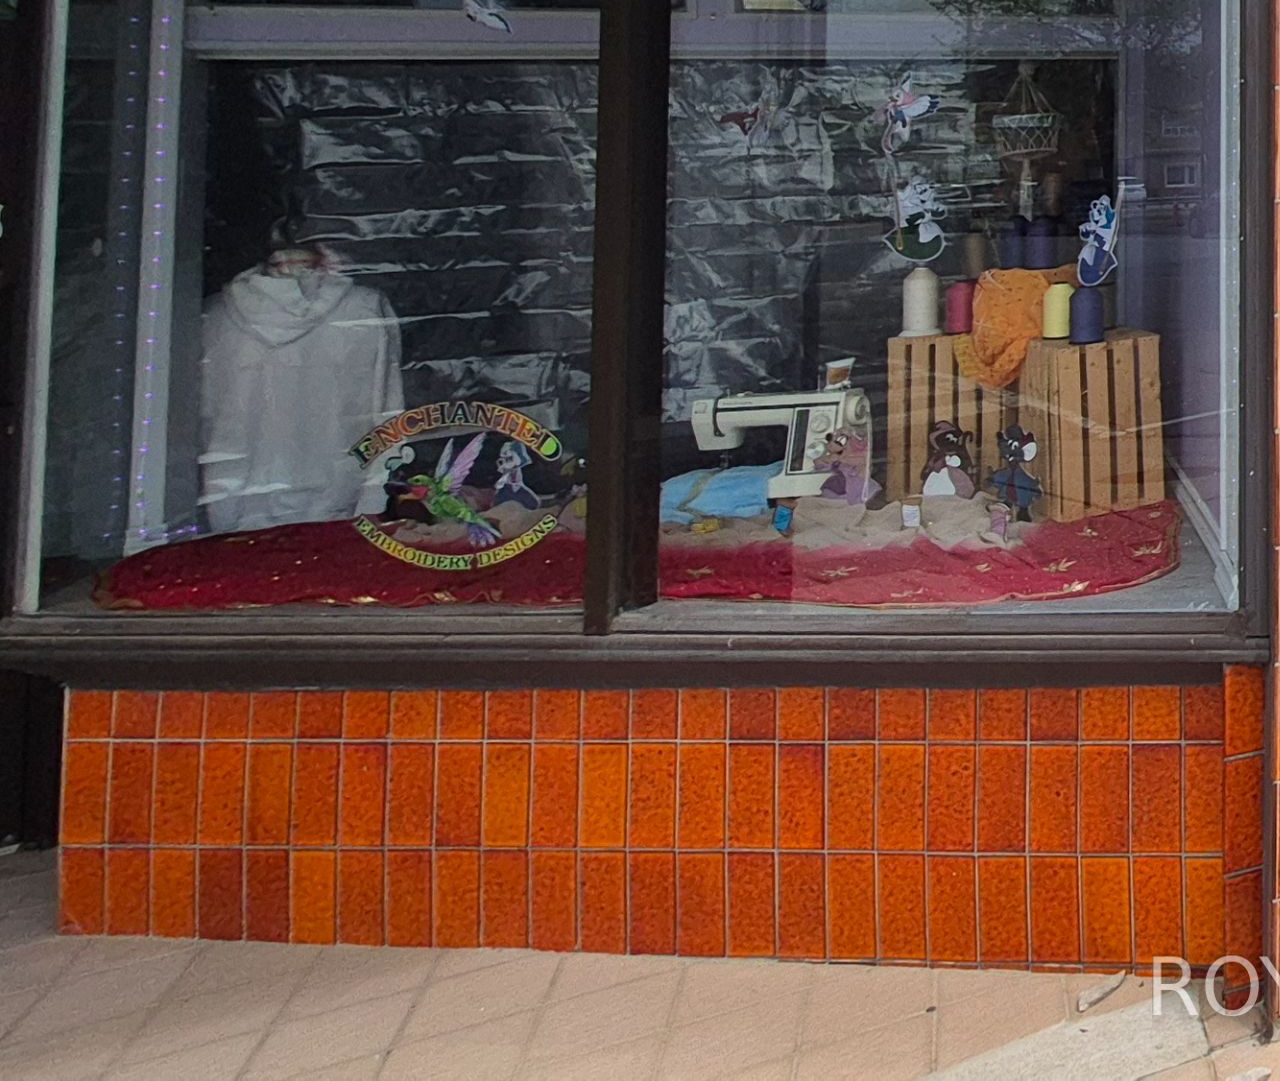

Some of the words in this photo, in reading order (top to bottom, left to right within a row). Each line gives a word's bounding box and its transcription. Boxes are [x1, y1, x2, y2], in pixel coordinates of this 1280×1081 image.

[349, 401, 562, 469] ENCHANTED
[354, 514, 473, 570] EMBROIDERY
[475, 513, 558, 567] DESIGNS
